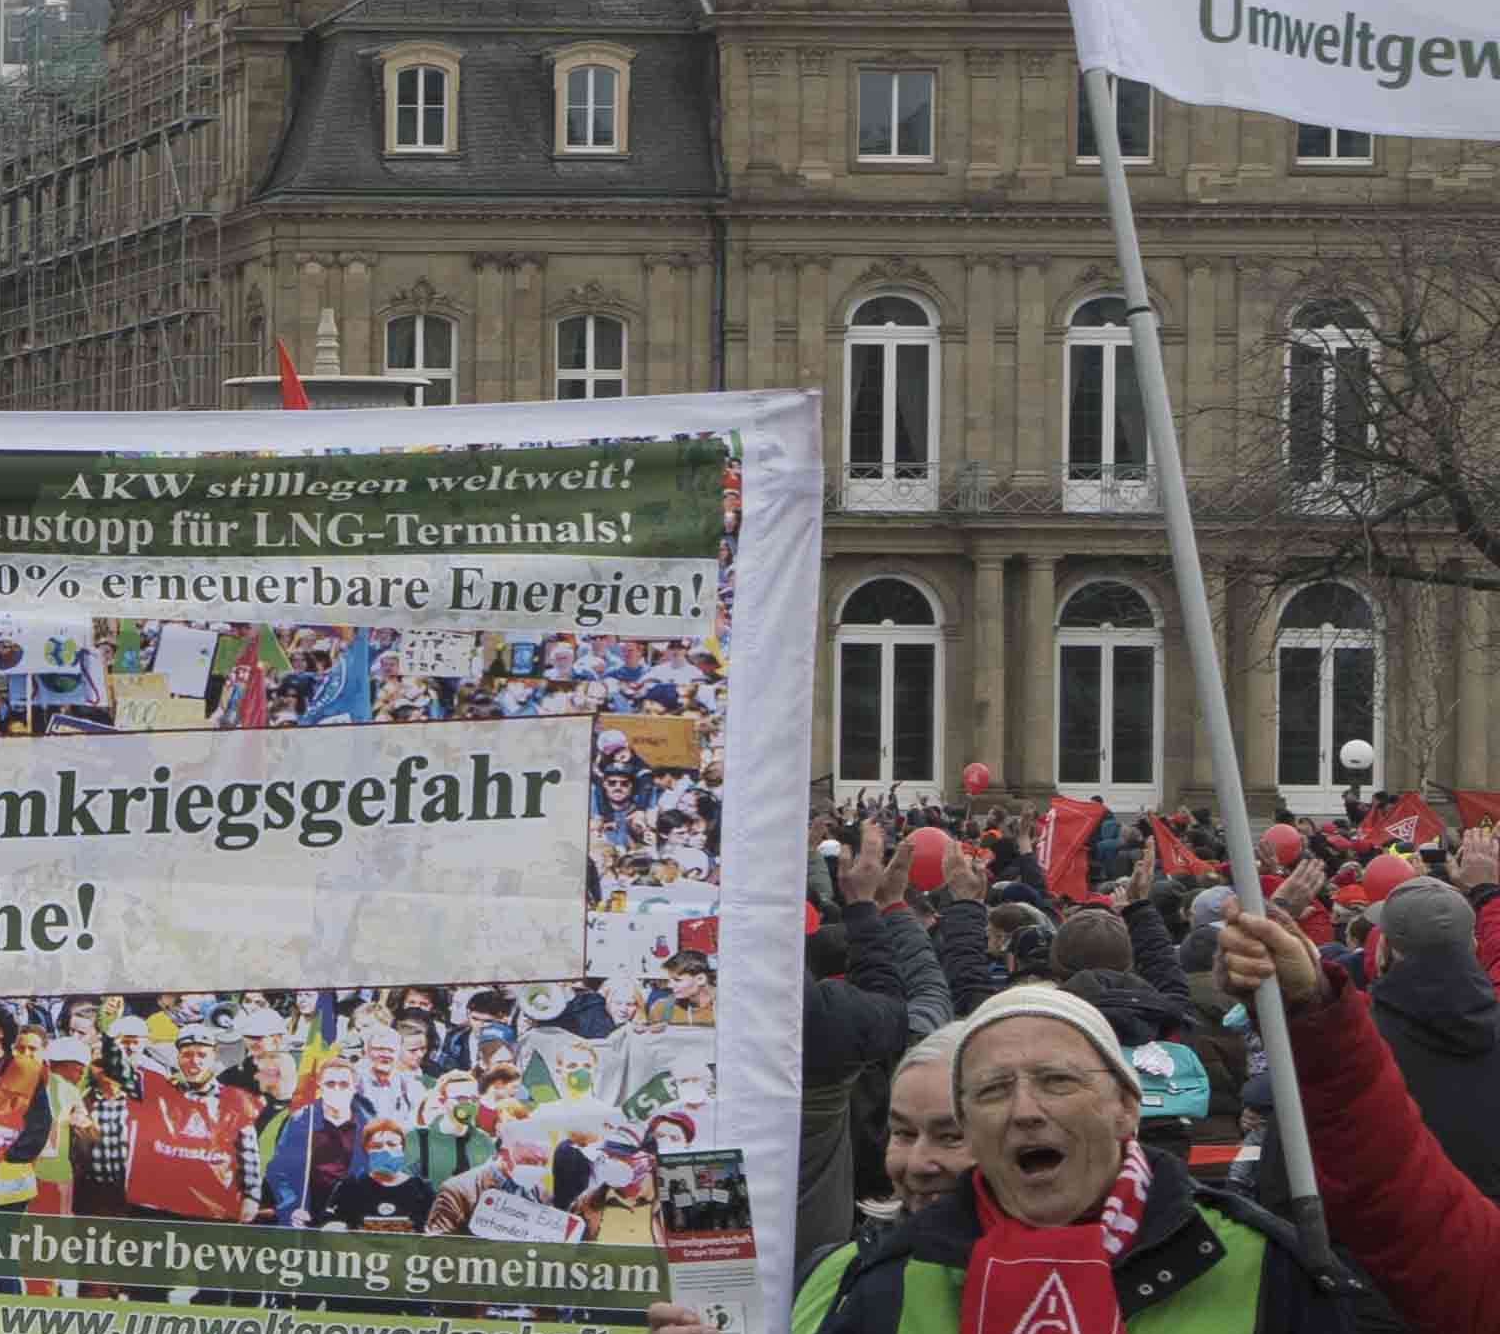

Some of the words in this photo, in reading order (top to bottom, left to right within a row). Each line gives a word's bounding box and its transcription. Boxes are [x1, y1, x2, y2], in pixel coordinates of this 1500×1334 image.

[60, 471, 196, 501] AKW
[205, 471, 409, 502] stilllegen
[426, 458, 635, 493] weltweit!
[168, 511, 239, 548] für
[254, 511, 634, 549] LNG-Terminals!
[101, 565, 431, 610] erneuerbare
[446, 566, 704, 628] Energien!
[404, 1249, 661, 1294] gemeinsam
